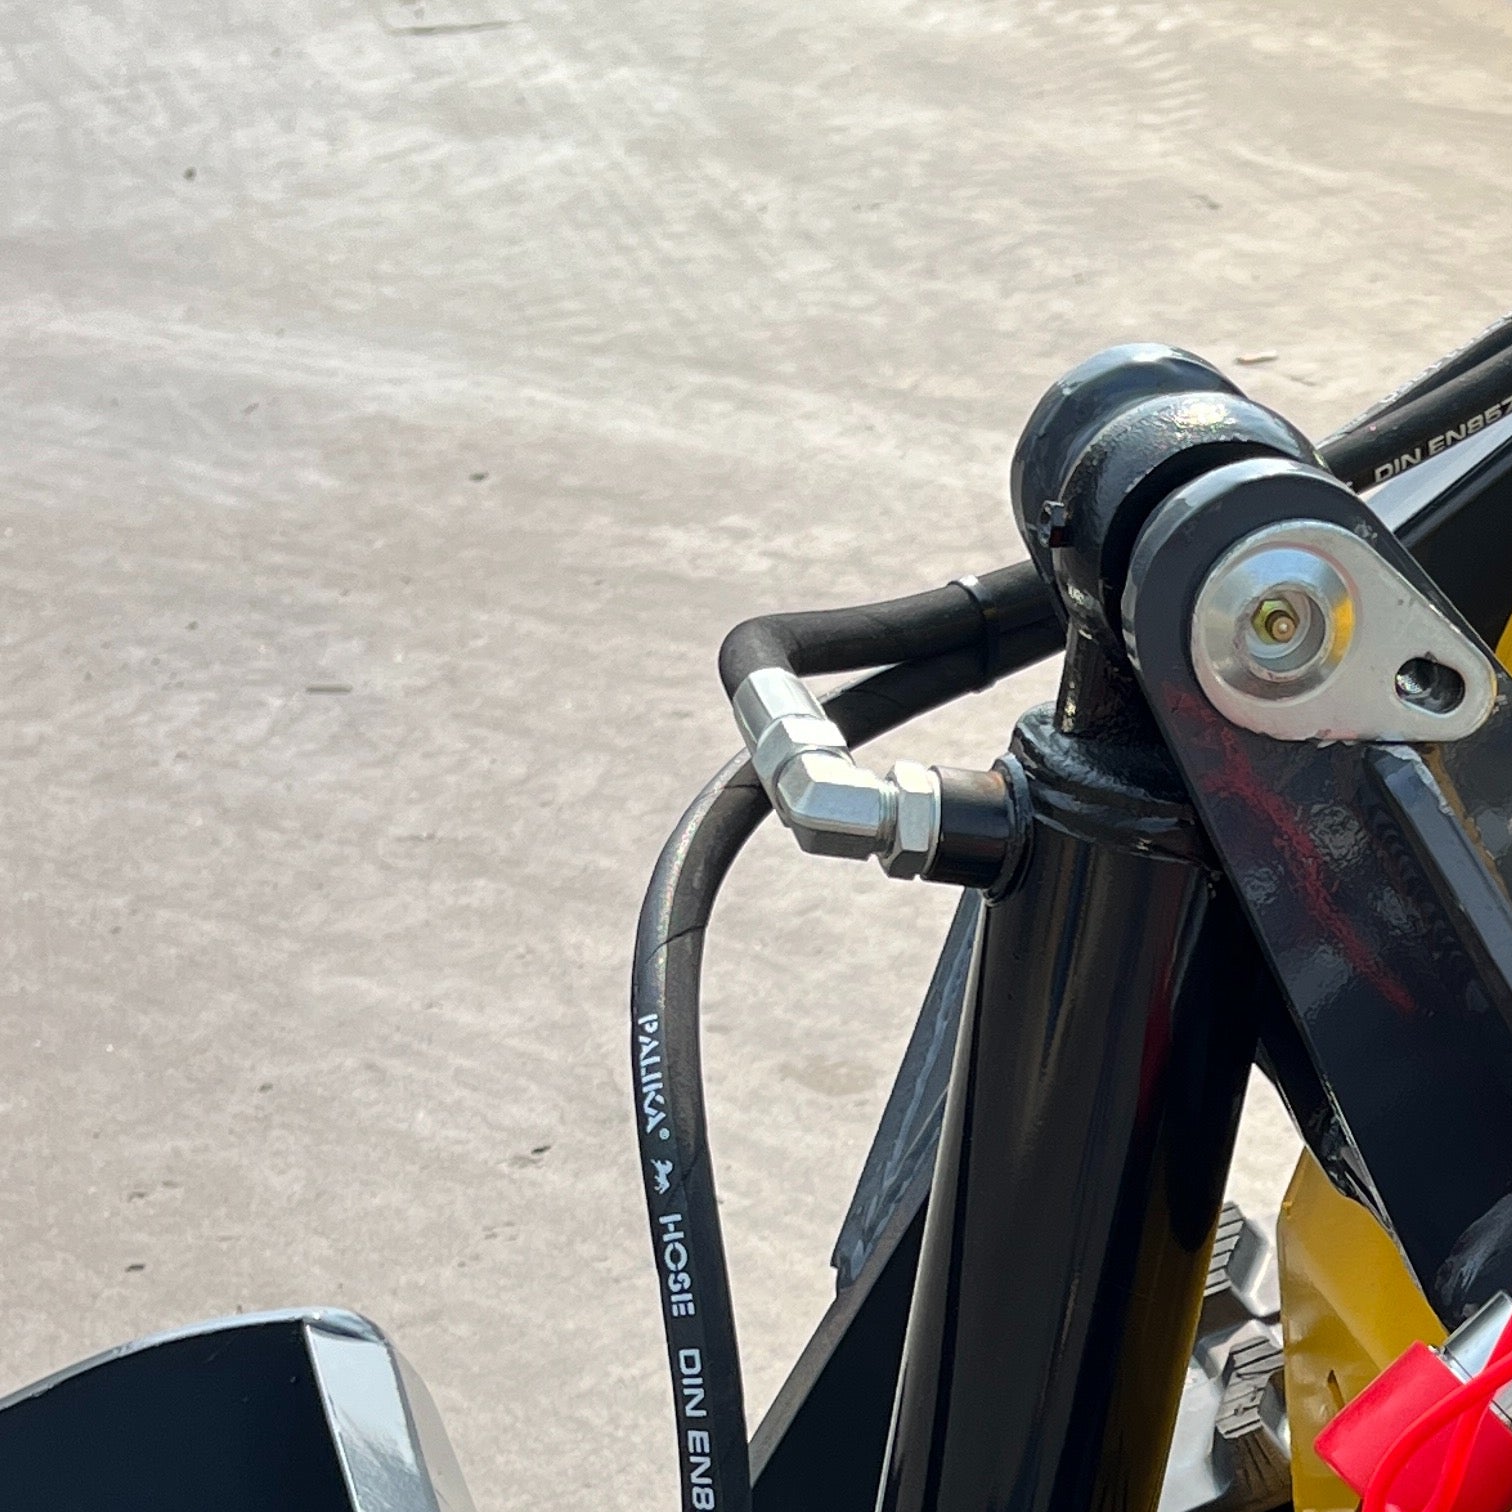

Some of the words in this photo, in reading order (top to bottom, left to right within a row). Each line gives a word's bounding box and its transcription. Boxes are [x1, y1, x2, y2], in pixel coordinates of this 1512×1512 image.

[1373, 446, 1422, 485] DIN
[658, 1212, 696, 1318] HOSE
[678, 1348, 708, 1418] DIN
